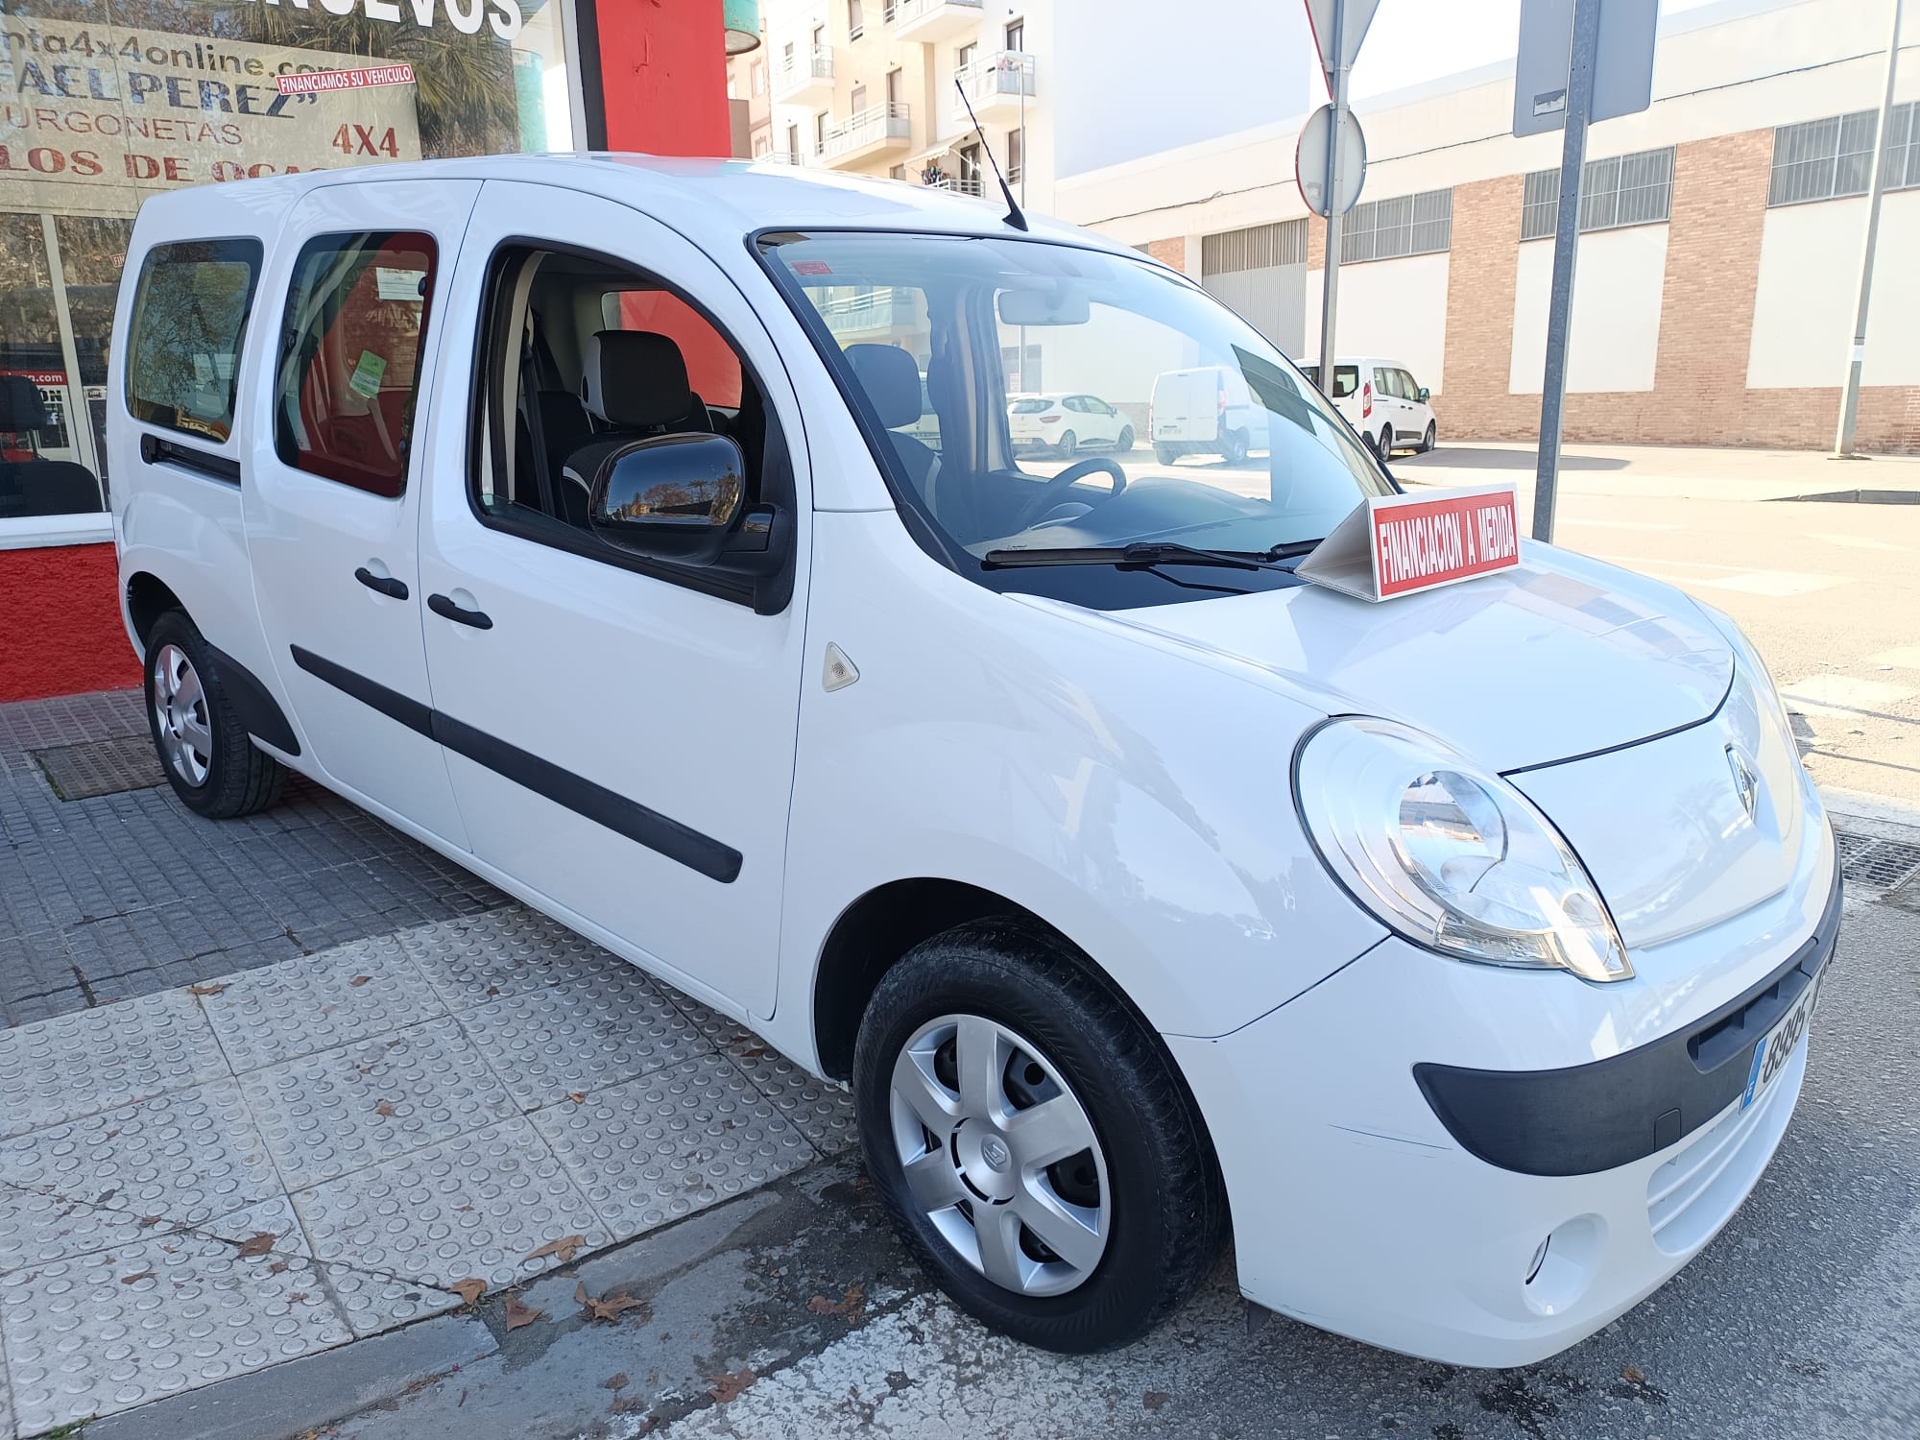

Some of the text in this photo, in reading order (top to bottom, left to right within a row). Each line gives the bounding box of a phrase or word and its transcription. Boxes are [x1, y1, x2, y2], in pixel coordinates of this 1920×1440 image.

[280, 66, 411, 93] FINANCIAMOS SU VEHICULO
[124, 153, 195, 183] DE
[1379, 504, 1516, 585] FINANCIACION A MEDIDA
